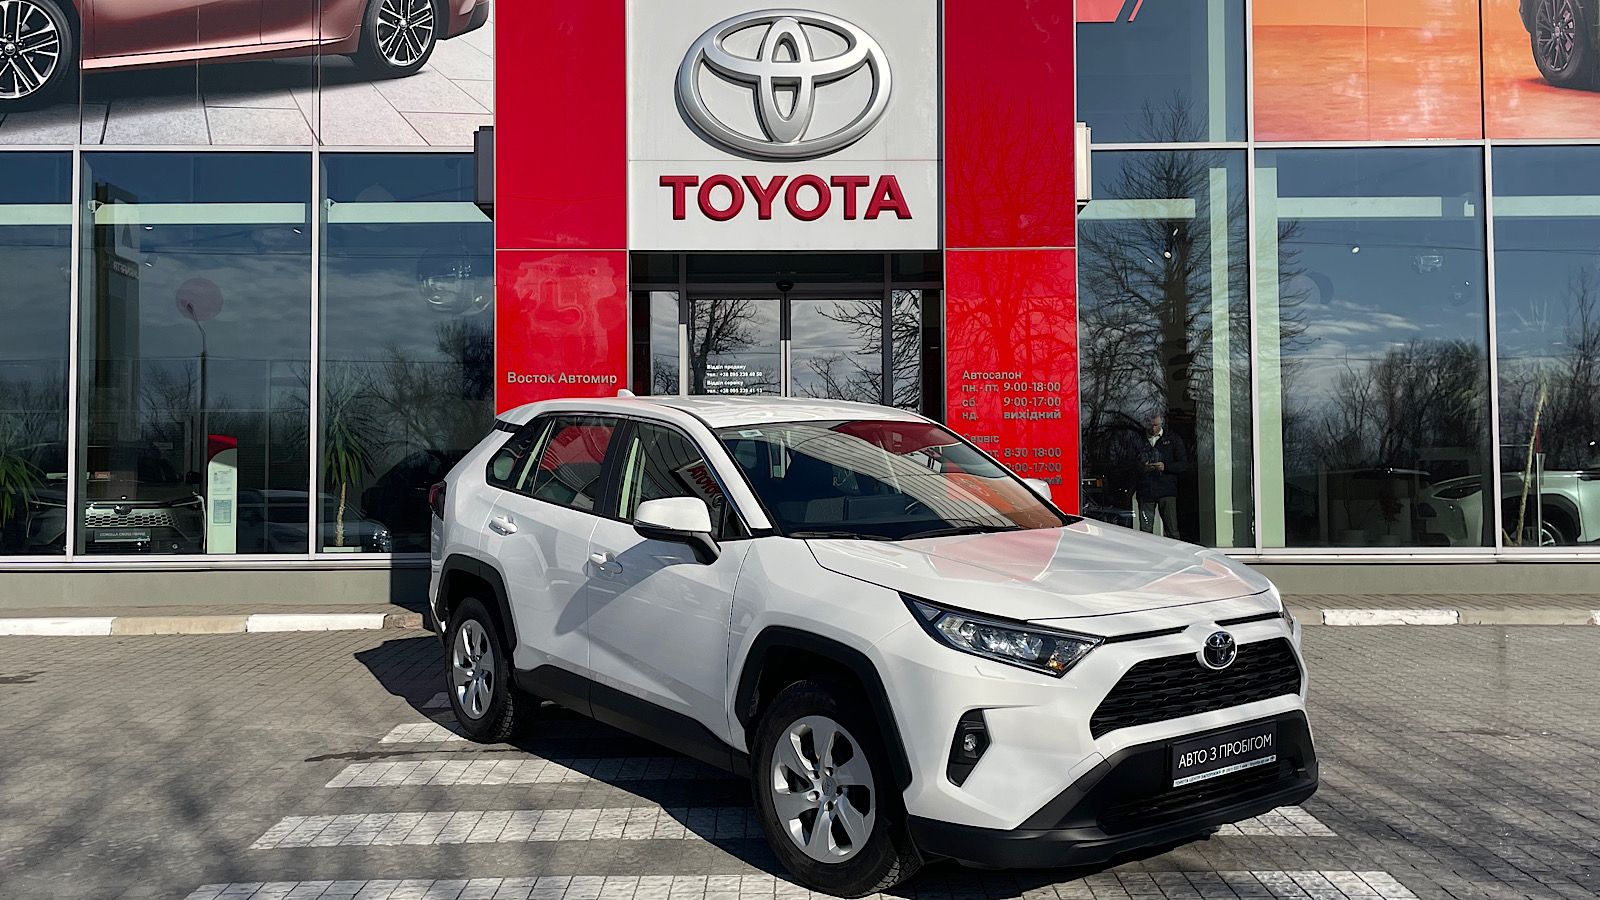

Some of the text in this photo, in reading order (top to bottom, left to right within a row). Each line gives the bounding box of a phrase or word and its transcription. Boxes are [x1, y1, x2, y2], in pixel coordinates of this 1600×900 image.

[659, 174, 913, 221] TOYOTA
[508, 372, 617, 386] Восток Автомир
[962, 370, 1022, 380] Автосалон
[962, 397, 978, 407] сб.
[962, 409, 1061, 420] нд. вихідний
[1178, 750, 1207, 768] АВТО
[1210, 747, 1217, 760] З
[1219, 734, 1272, 758] ПРОБІГОМ
